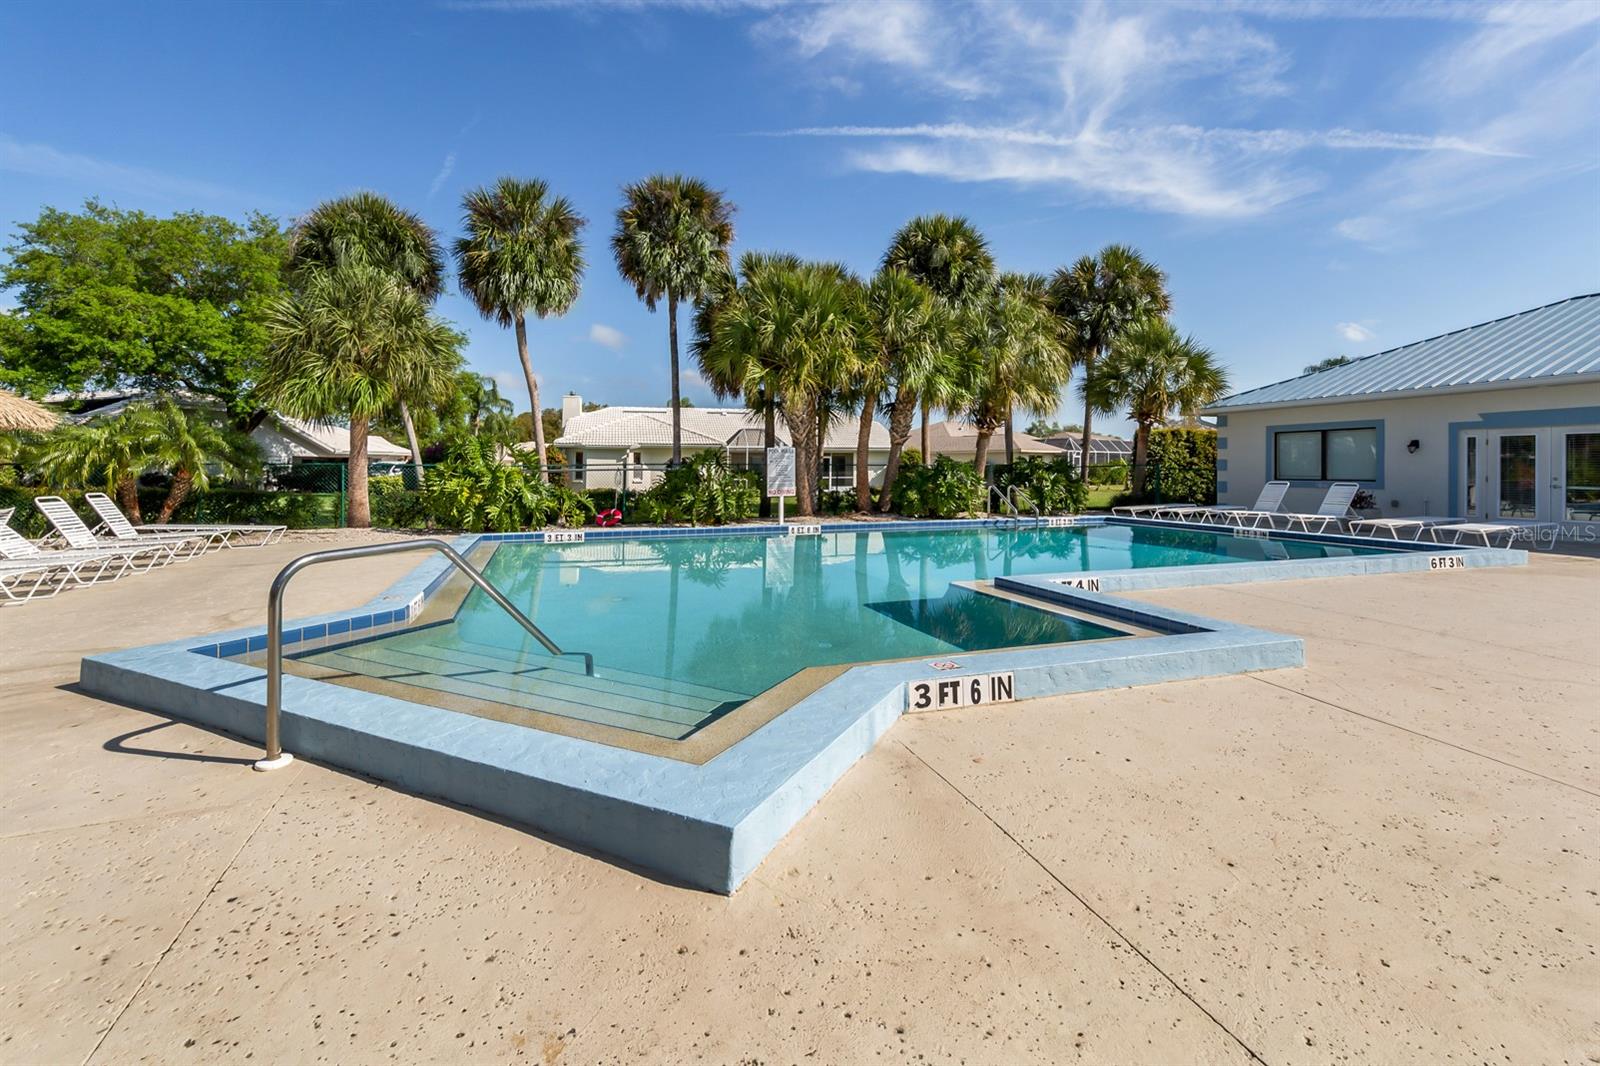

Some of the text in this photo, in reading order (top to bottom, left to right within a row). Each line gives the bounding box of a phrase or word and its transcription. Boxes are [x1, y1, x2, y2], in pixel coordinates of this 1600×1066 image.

[547, 534, 552, 543] 3
[567, 533, 572, 542] 3
[1430, 556, 1464, 569] 6 FT 3 IN
[1087, 578, 1100, 592] IN
[913, 675, 1013, 709] 3 FT 6 IN
